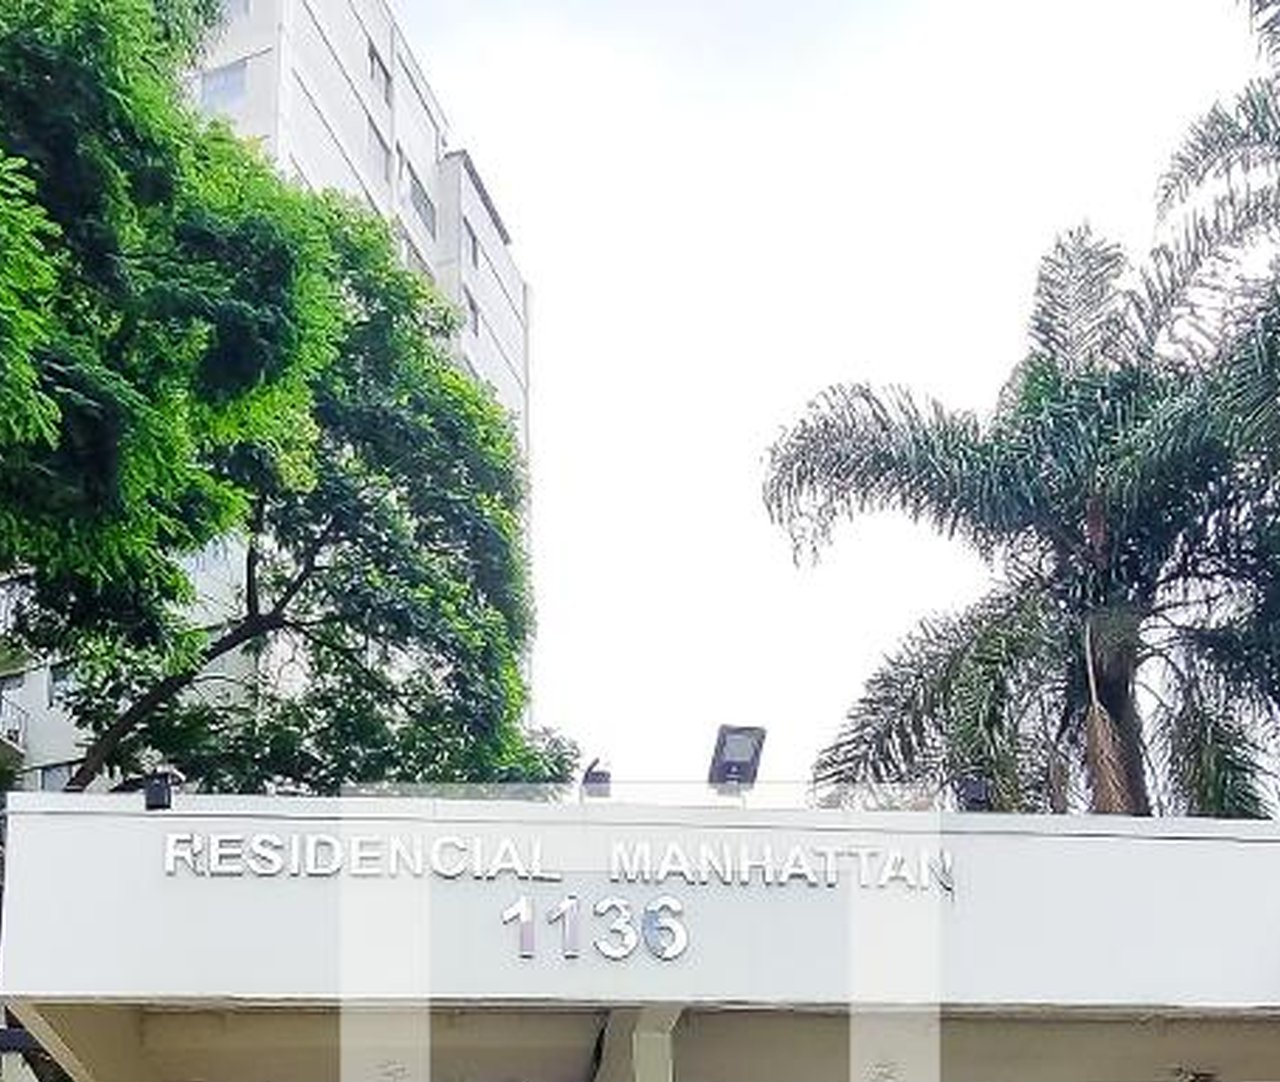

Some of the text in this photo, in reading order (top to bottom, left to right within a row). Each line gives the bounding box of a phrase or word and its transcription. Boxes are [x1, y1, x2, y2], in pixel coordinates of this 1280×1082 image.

[163, 832, 955, 892] RESIDENCIAL MANHATTAN
[500, 895, 689, 961] 1136
